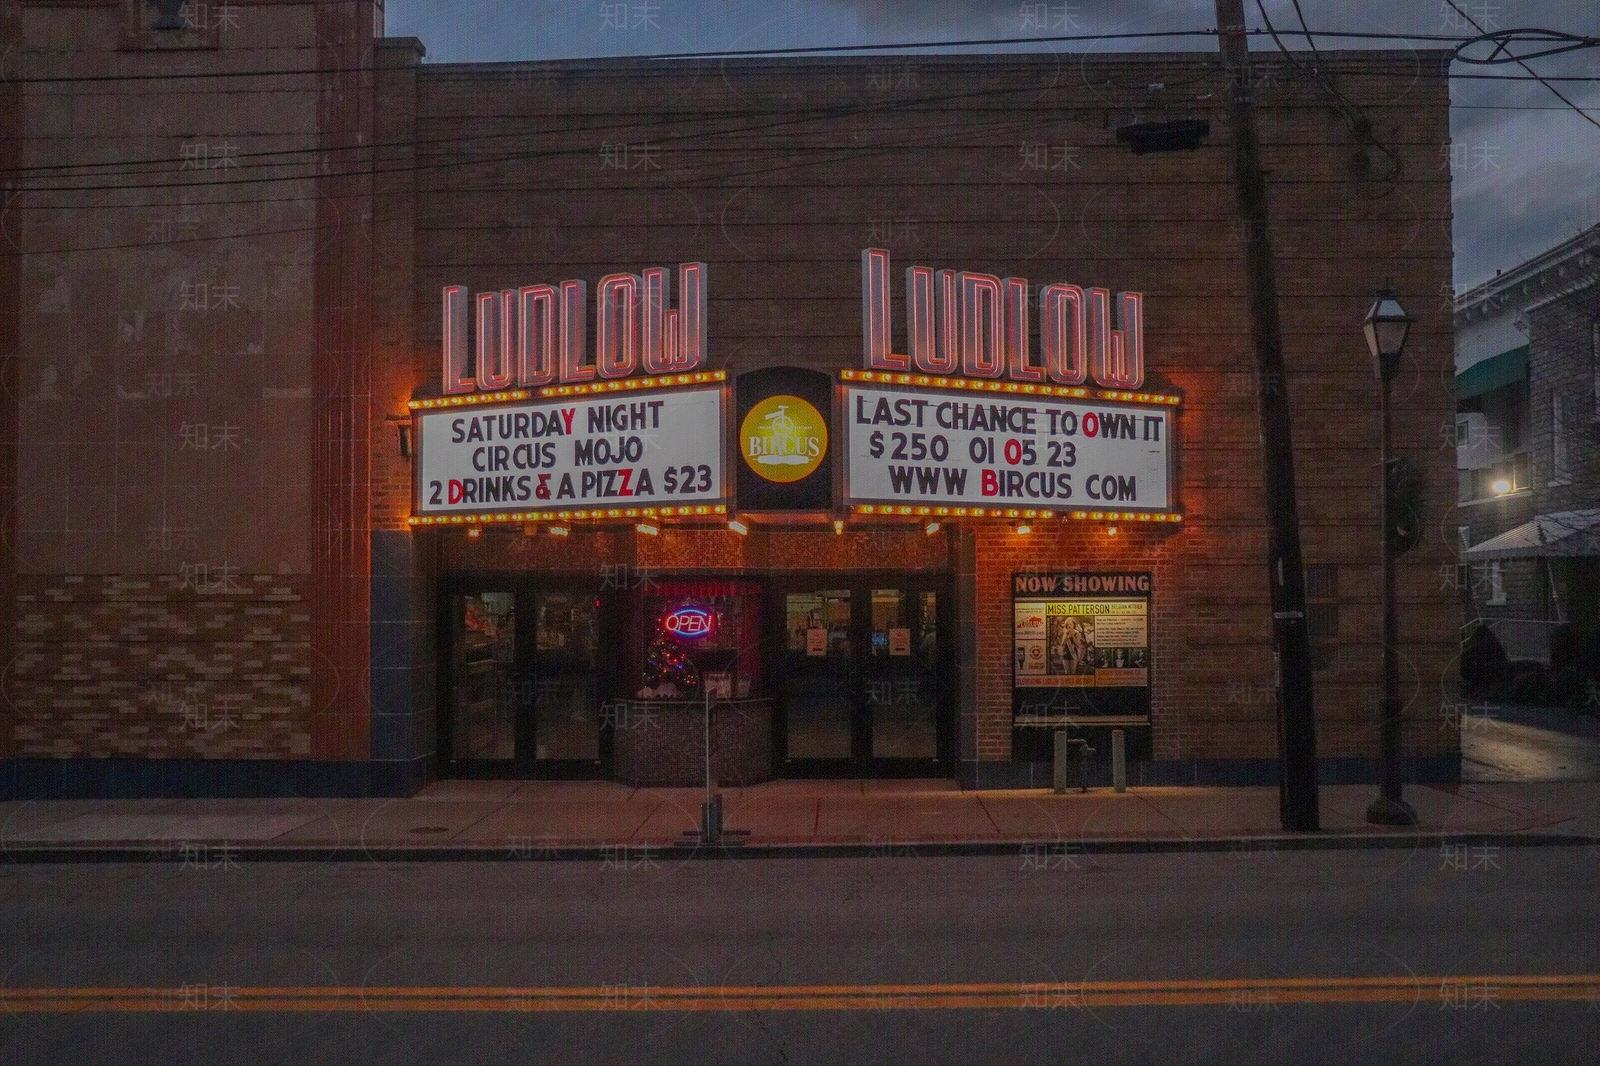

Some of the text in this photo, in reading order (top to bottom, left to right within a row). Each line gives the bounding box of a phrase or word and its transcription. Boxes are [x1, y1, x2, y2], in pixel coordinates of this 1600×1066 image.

[443, 262, 707, 395] LUDLOW
[862, 248, 1144, 390] LUDLOW
[451, 407, 576, 443] SATURDAY
[587, 400, 664, 434] NIGHT
[856, 395, 928, 428] LAST
[936, 401, 1036, 435] CHANCE
[1046, 409, 1078, 436] TO
[1082, 412, 1136, 441] OWN
[1143, 416, 1164, 442] IT
[472, 442, 557, 472] CIRCUS
[574, 435, 644, 467] MOJO
[748, 436, 820, 457] BIRCUS
[1047, 441, 1077, 468] 23
[428, 464, 713, 505] 2 DRINKS & A PIZZA $23
[889, 465, 1137, 502] WWW BIRCUS COM
[1015, 575, 1149, 593] NOW SHOWING
[666, 615, 712, 631] OPEN
[1047, 604, 1067, 615] MISS
[1069, 603, 1110, 615] PATTERSON
